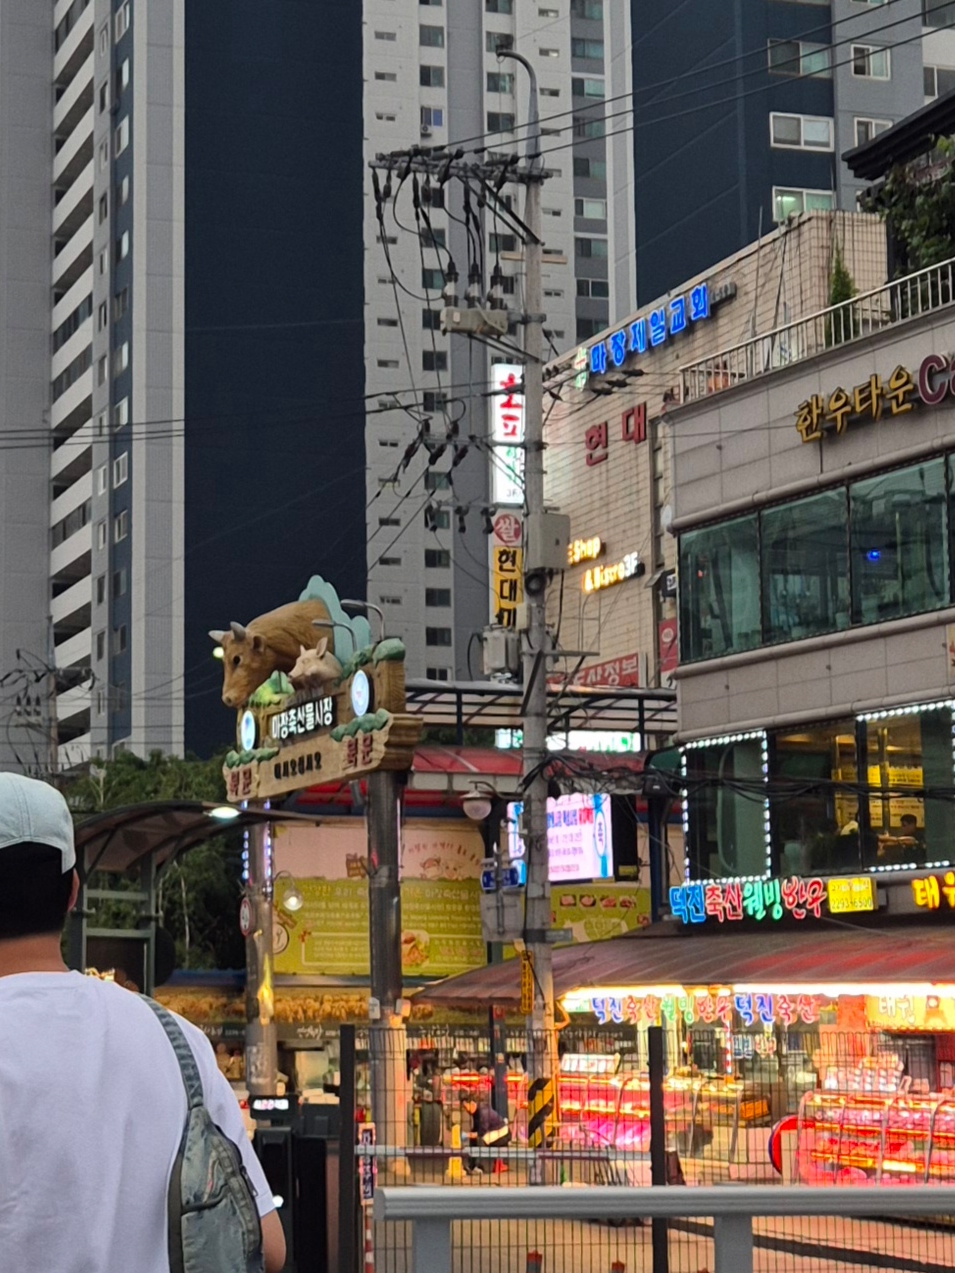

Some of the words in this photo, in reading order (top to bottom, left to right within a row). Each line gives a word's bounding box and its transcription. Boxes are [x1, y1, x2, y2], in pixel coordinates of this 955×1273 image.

[589, 283, 709, 374] 마장제일교회
[796, 365, 915, 443] 한우타운
[272, 696, 332, 739] 마장축산물시장
